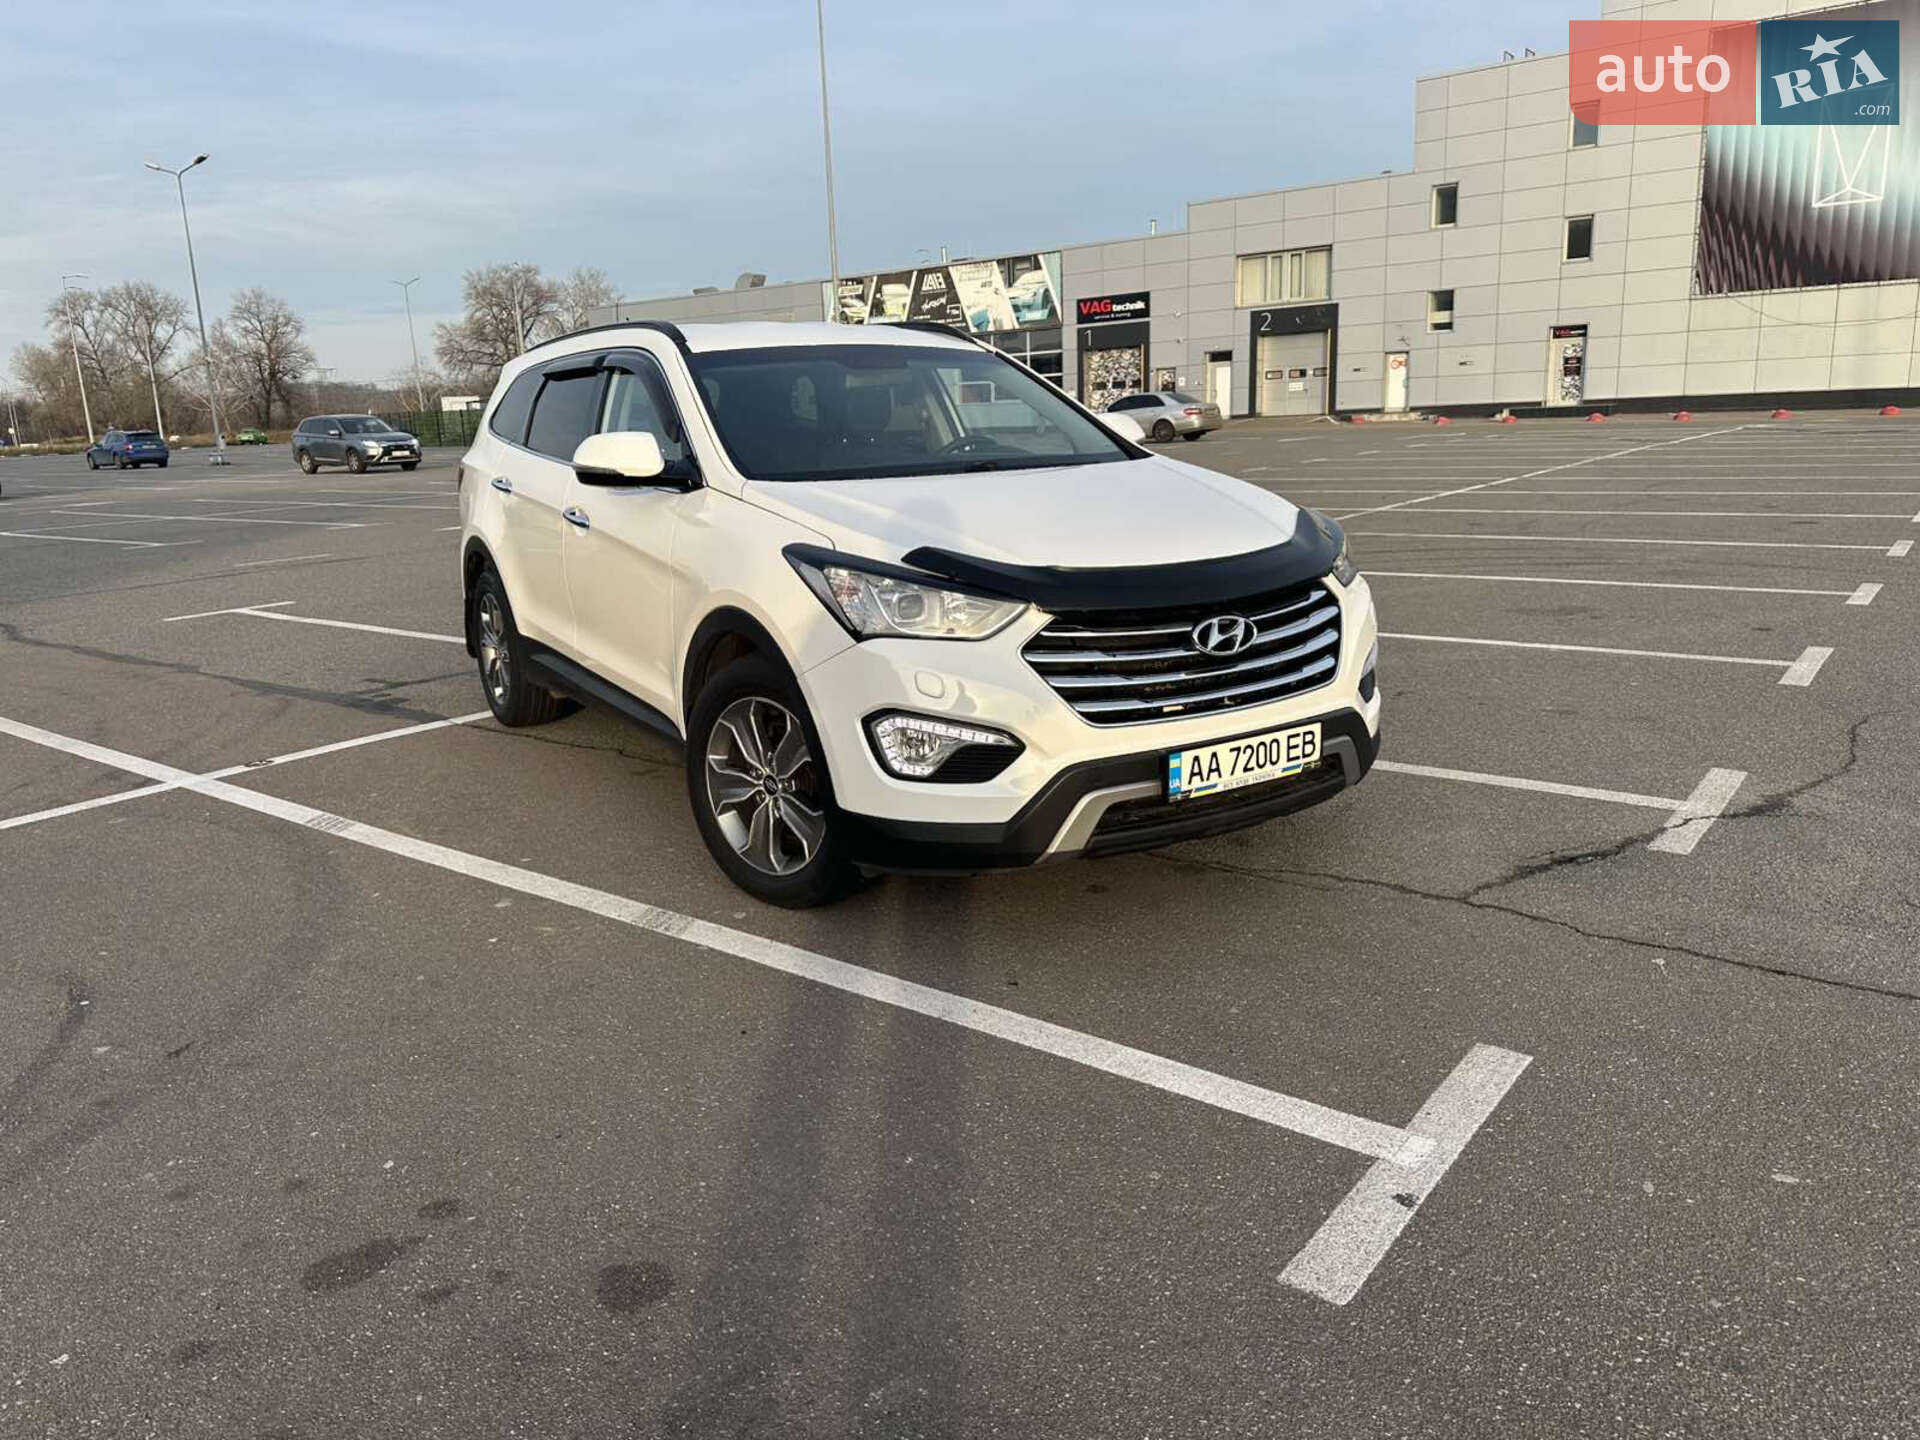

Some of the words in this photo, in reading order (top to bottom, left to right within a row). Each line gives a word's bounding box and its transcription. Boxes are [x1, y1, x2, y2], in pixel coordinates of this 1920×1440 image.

[1260, 312, 1272, 331] 2
[1084, 330, 1092, 346] 1
[1188, 751, 1222, 785] AA
[1229, 738, 1281, 776] 7200
[1286, 730, 1316, 762] EB
